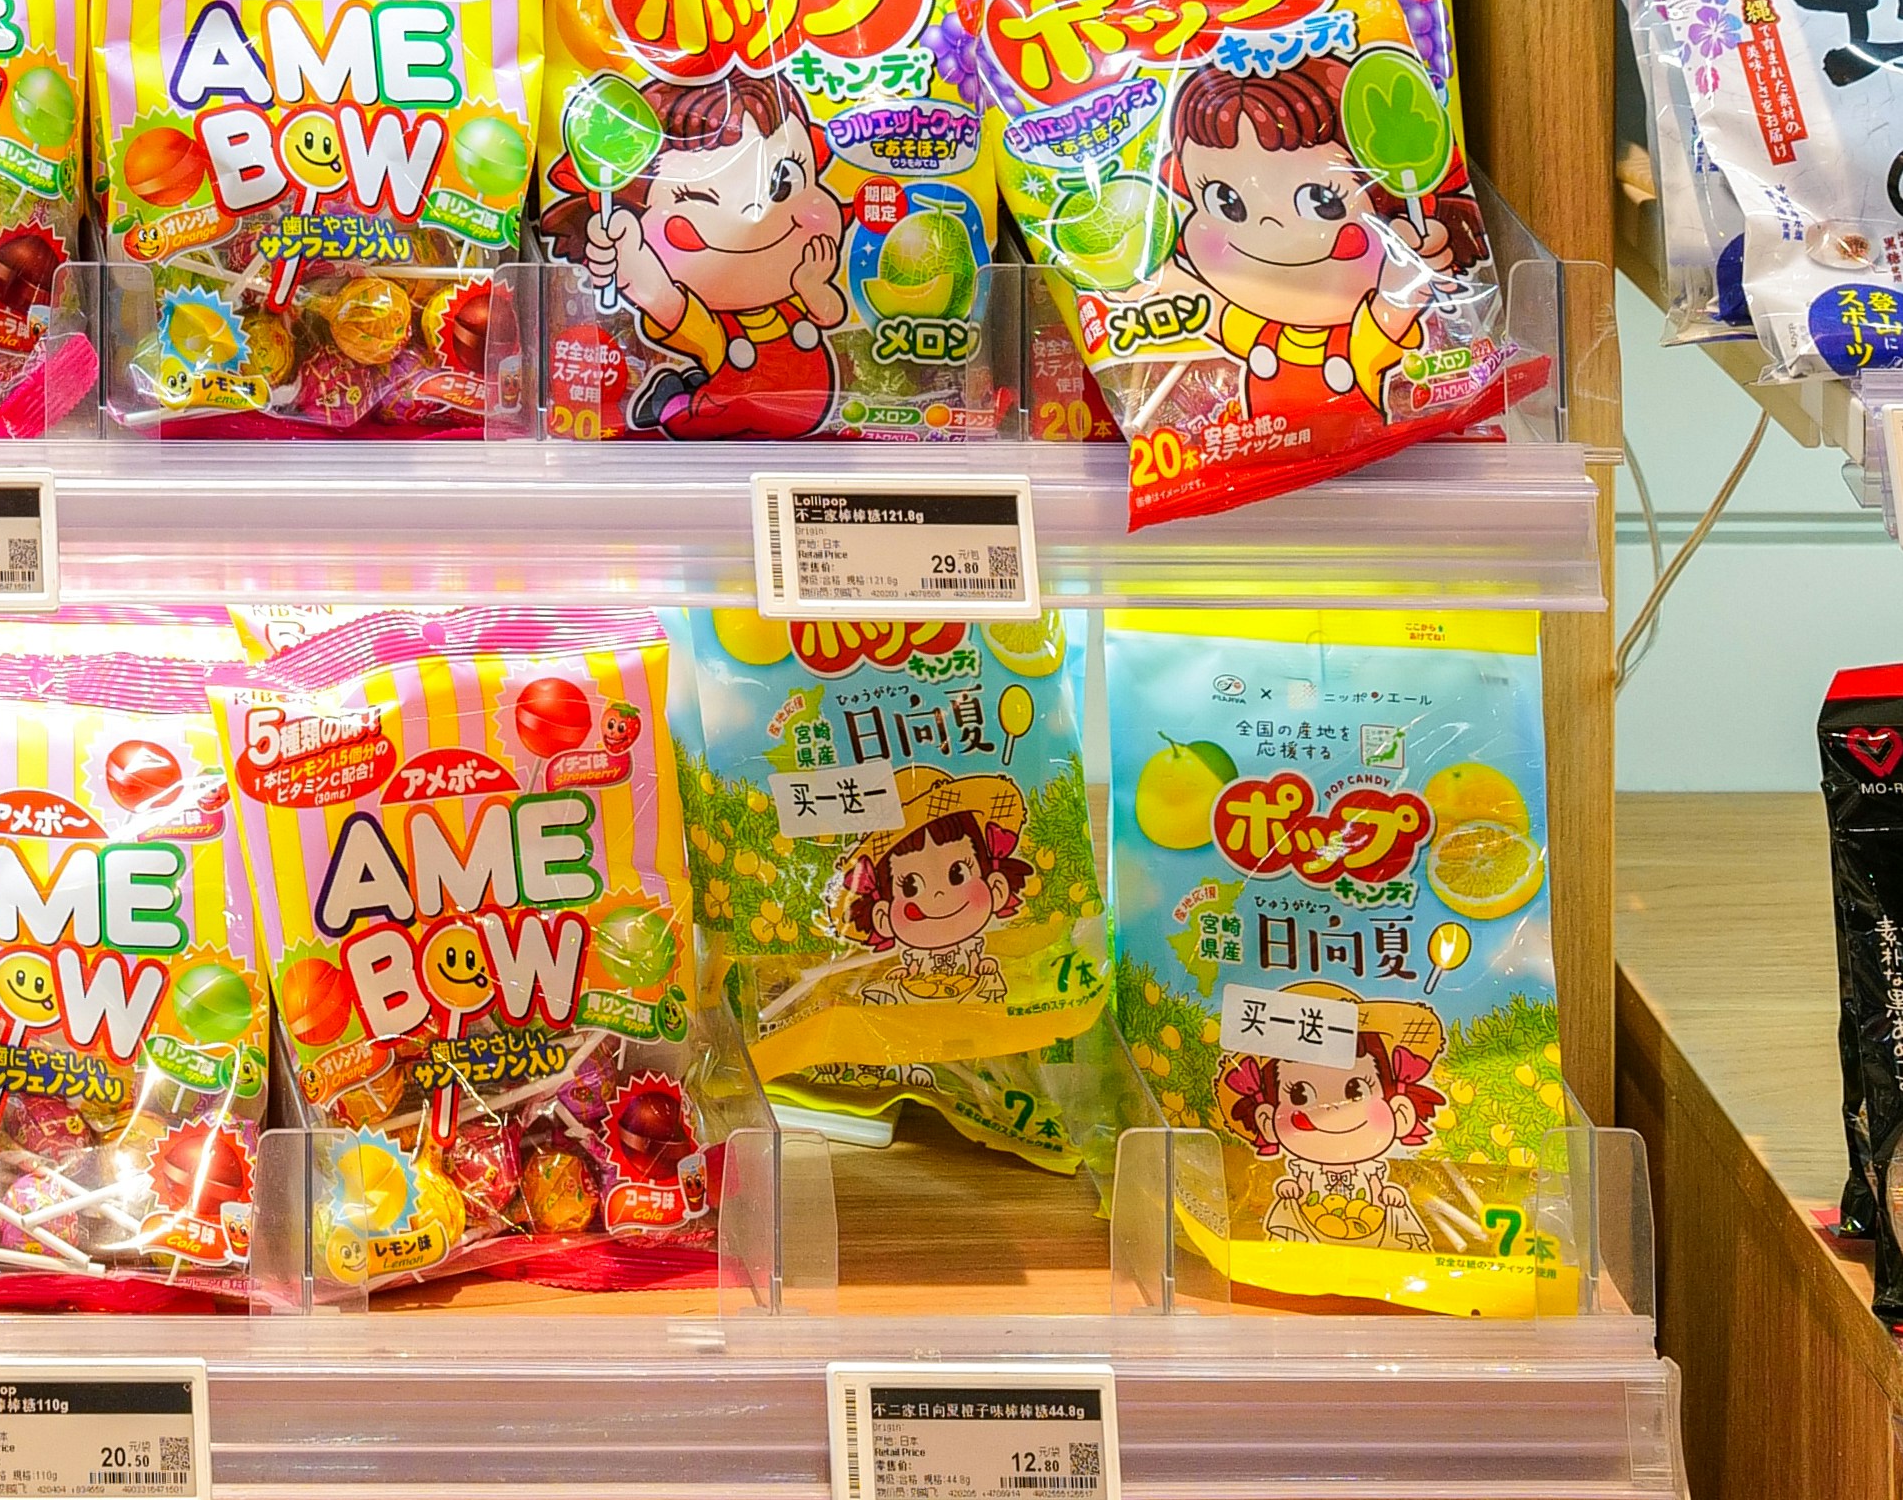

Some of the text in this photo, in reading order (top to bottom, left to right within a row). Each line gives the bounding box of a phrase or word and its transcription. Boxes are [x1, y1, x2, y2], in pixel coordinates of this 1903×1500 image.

[791, 49, 932, 96] キャンディ
[1745, 44, 1789, 158] 美味しさをお届け
[282, 216, 392, 236] 歯にやさしい
[259, 237, 410, 260] サンフェノン入り
[881, 320, 975, 361] メロン
[1204, 416, 1286, 449] 安全な紙の
[1204, 430, 1312, 461] スティック使用
[1235, 719, 1352, 742] 全国の産地を
[791, 785, 887, 818] 买一送一
[1224, 785, 1418, 873] ポップ
[1335, 875, 1415, 905] キャンディ
[1258, 916, 1417, 983] 日向夏
[1241, 1000, 1356, 1044] 买一送一
[1485, 1207, 1556, 1260] 7本
[100, 1446, 151, 1469] 20.50
[1011, 1452, 1060, 1473] 12.80
